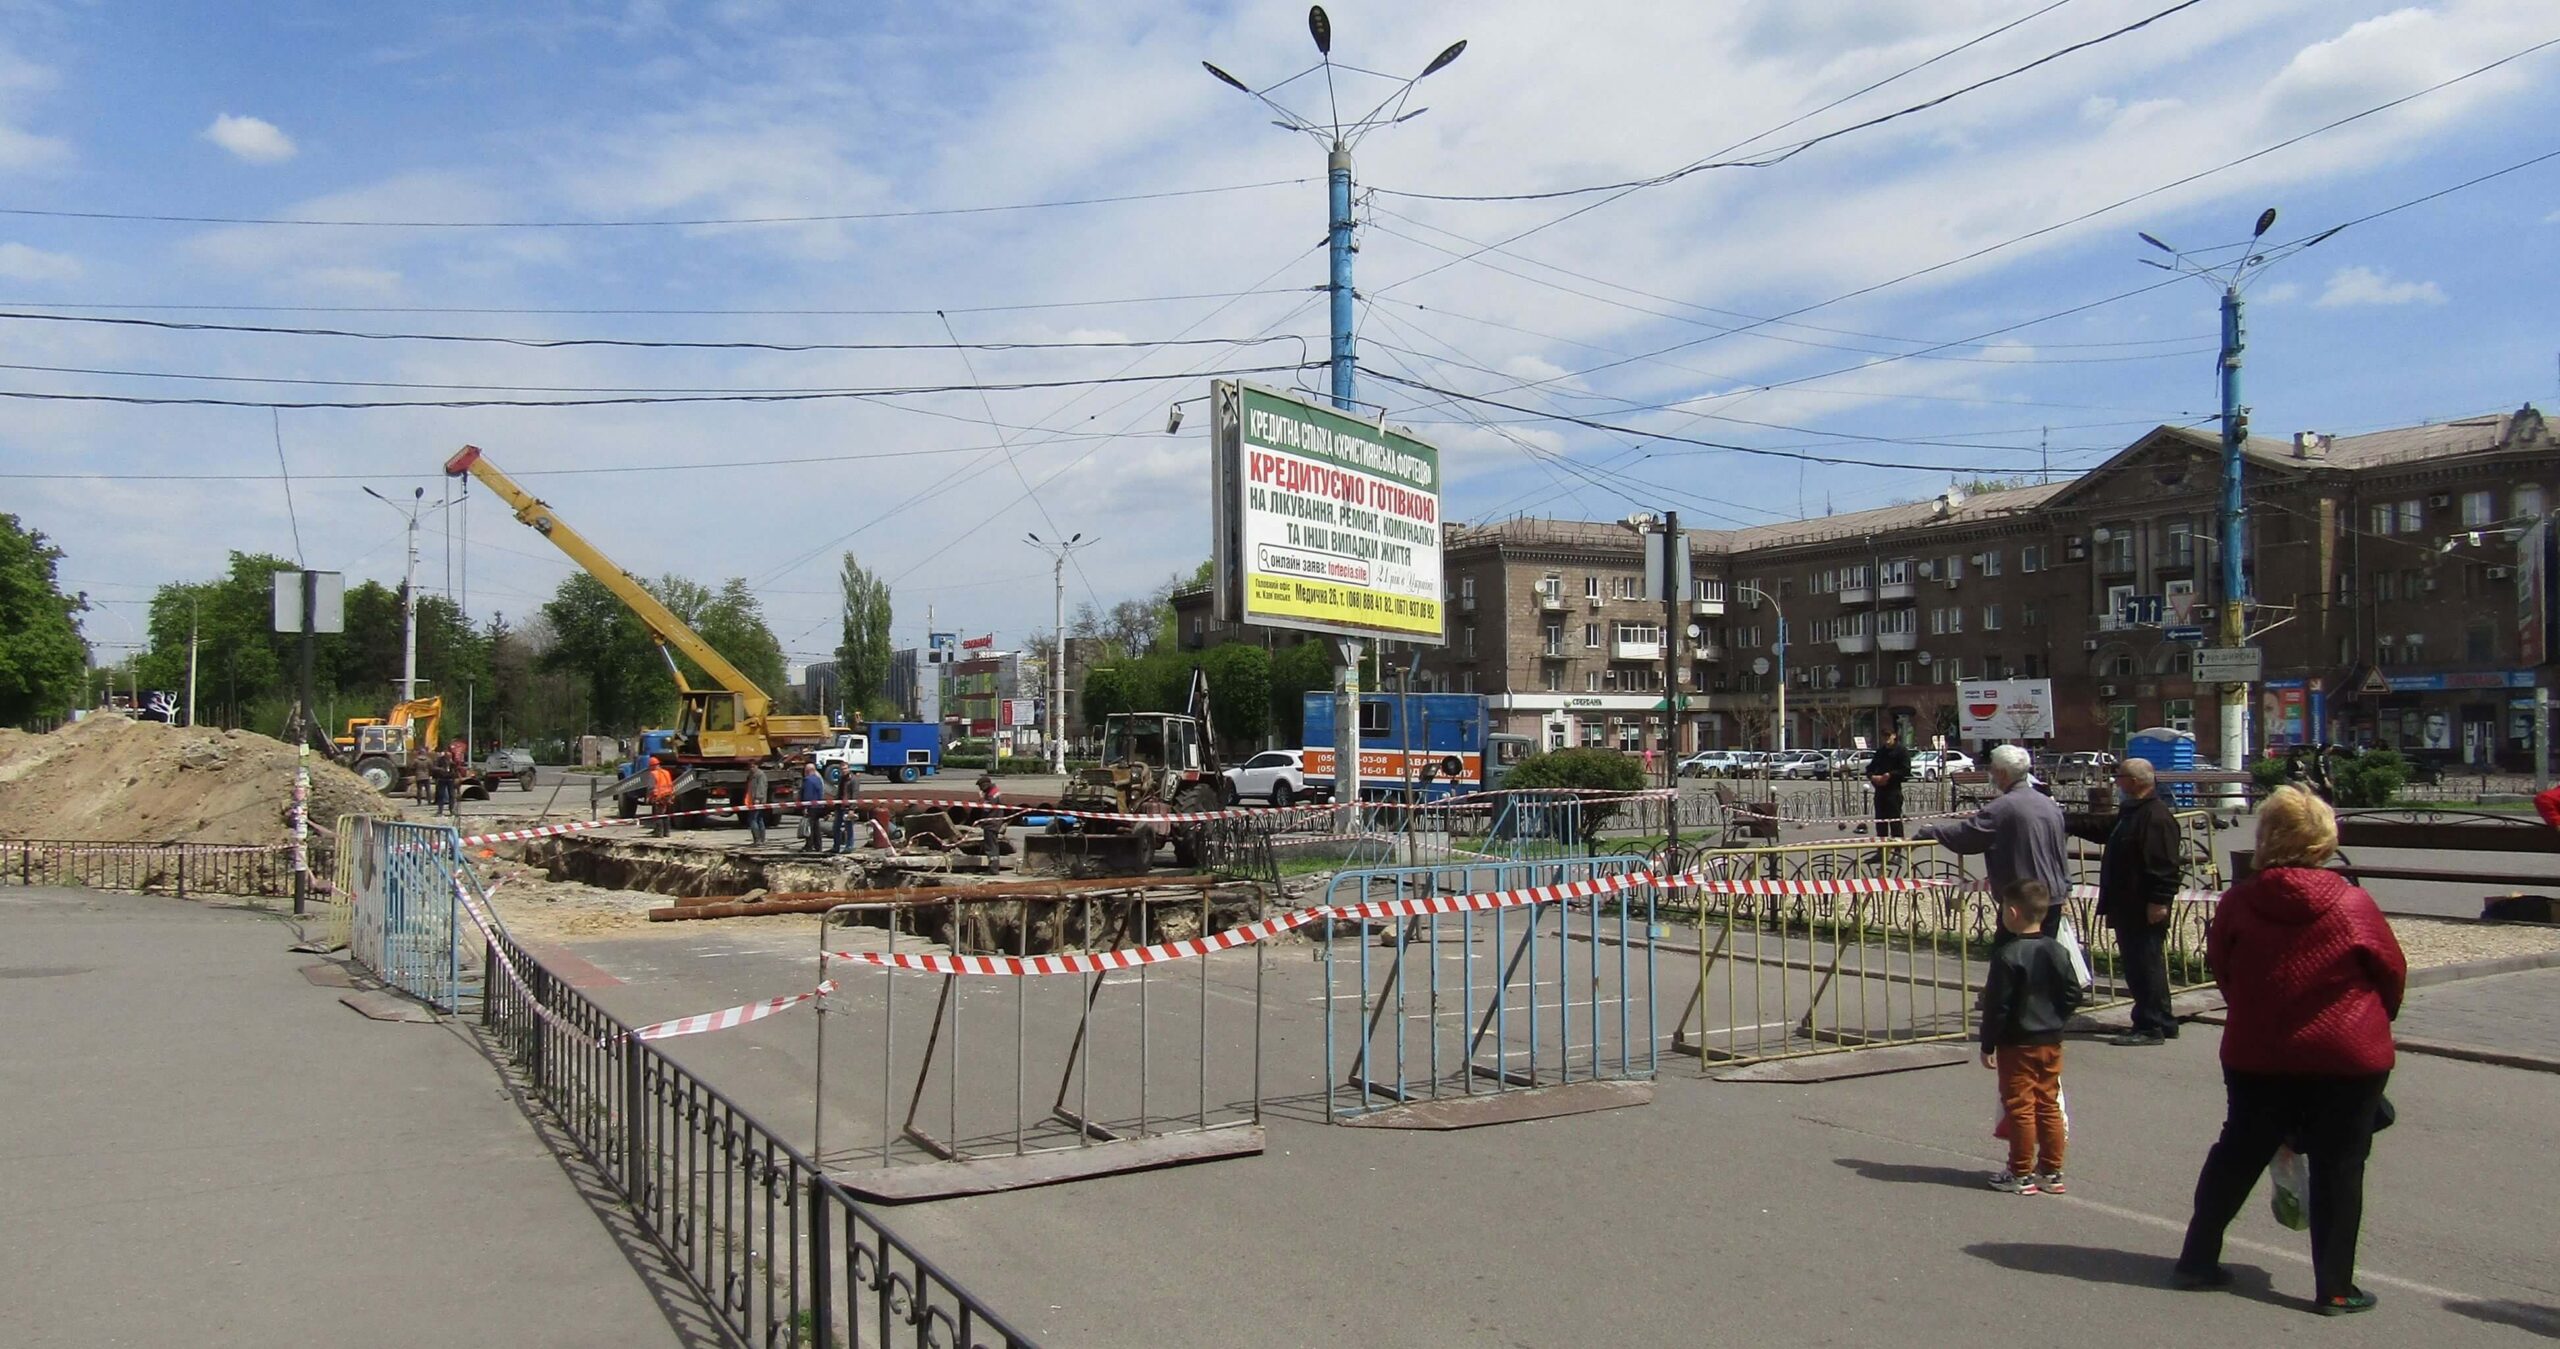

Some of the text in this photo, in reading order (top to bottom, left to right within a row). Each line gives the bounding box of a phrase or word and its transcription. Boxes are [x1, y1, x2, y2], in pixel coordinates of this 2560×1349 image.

[1250, 408, 1300, 448] КРЕДИТНА
[1301, 422, 1333, 456] СПІЛКА
[1335, 434, 1397, 475] «ХРИСТИЯНСЬКА
[1250, 451, 1435, 524] КРЕДИТУЄМО ГОТІВКОЮ
[1250, 487, 1435, 547] НА ЛІКУВАННЯ, РЕМОНТ, КОМУНАЛКУ
[1270, 554, 1367, 580] онлайн заява: fortecia.site
[1287, 523, 1411, 567] ТА ІНШІ ВИПАДКИ ЖИТТЯ
[1376, 564, 1389, 583] 21
[1295, 583, 1328, 604] Медична
[1375, 595, 1383, 611] 41
